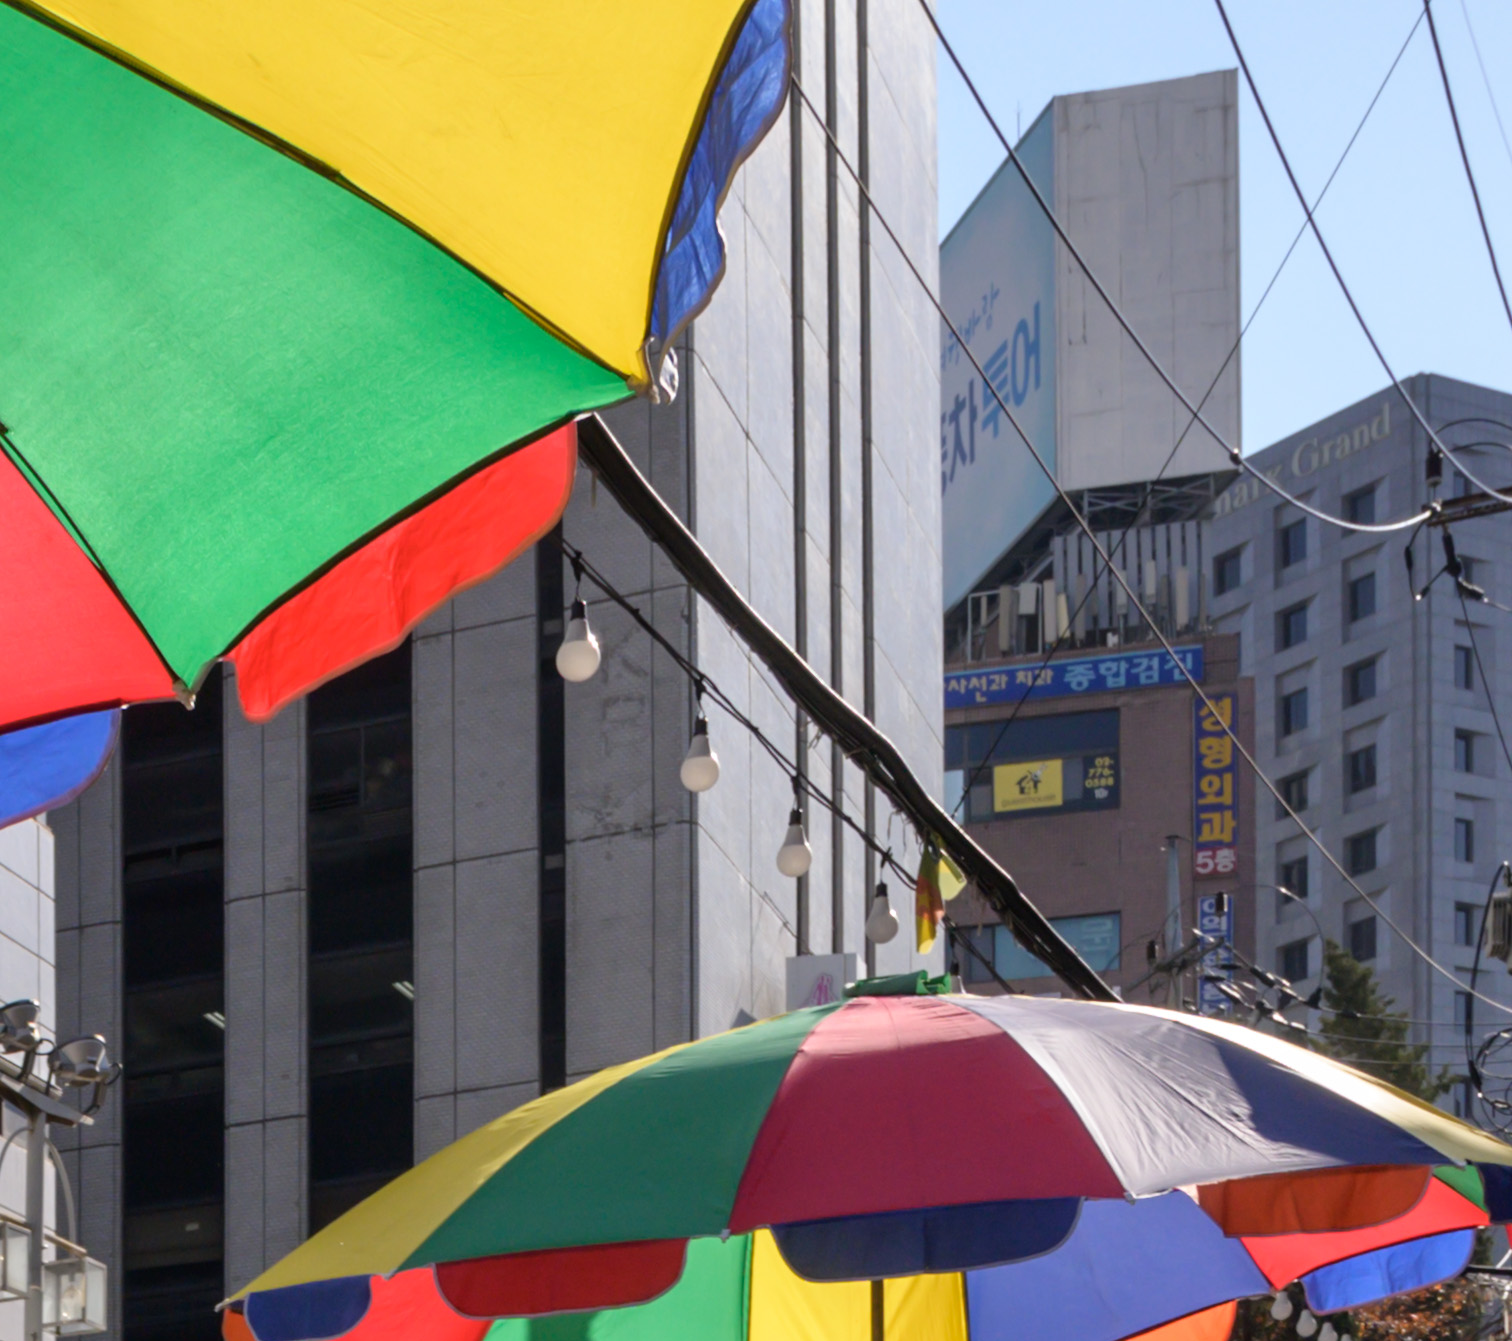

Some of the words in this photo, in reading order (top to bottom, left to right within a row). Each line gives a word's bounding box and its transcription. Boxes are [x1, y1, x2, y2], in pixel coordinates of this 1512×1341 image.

[1291, 402, 1390, 478] Grand
[946, 673, 1009, 702] 사선과
[1064, 652, 1194, 691] 종합검진
[1198, 696, 1237, 843] 성형외과
[1196, 849, 1237, 874] 5층
